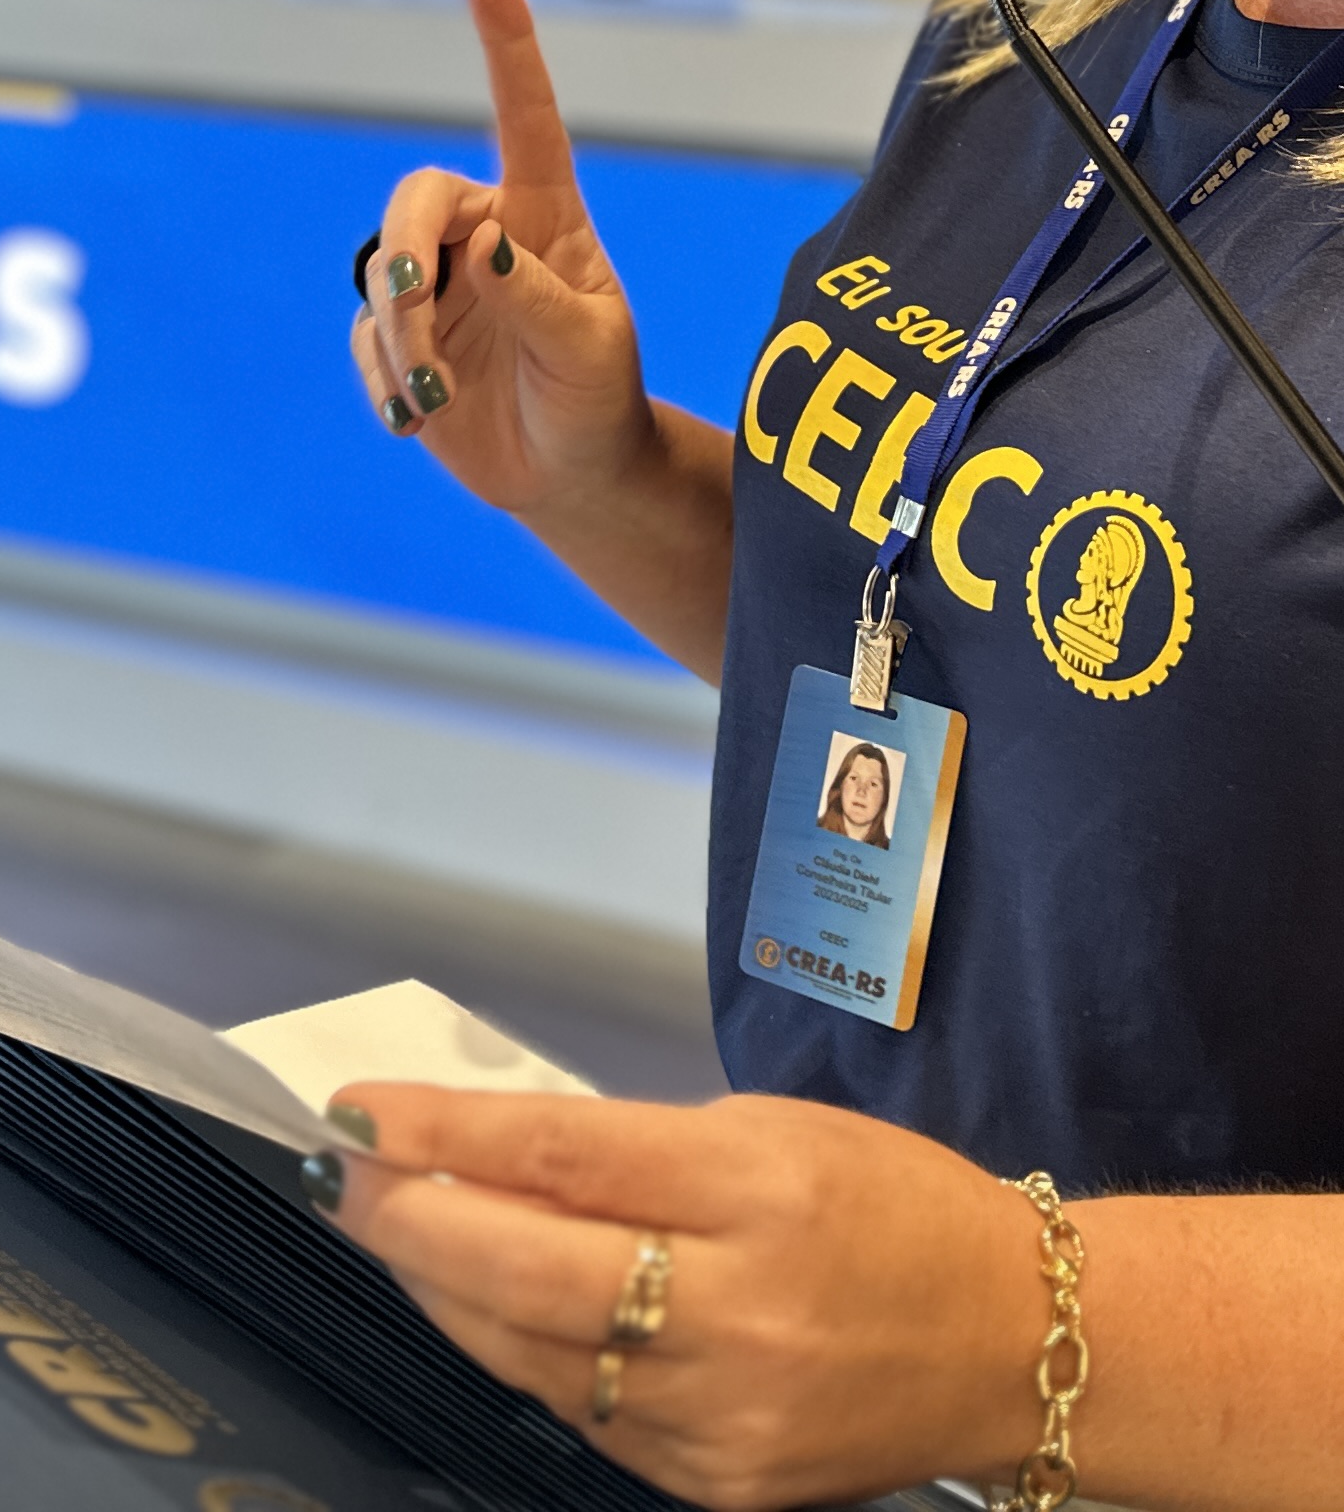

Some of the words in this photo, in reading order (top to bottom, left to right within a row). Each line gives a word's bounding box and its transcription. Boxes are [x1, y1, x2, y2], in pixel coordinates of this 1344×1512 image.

[1190, 109, 1291, 205] CREA-RS
[947, 296, 1017, 399] CREA-RS
[785, 945, 887, 998] CREA-RS
